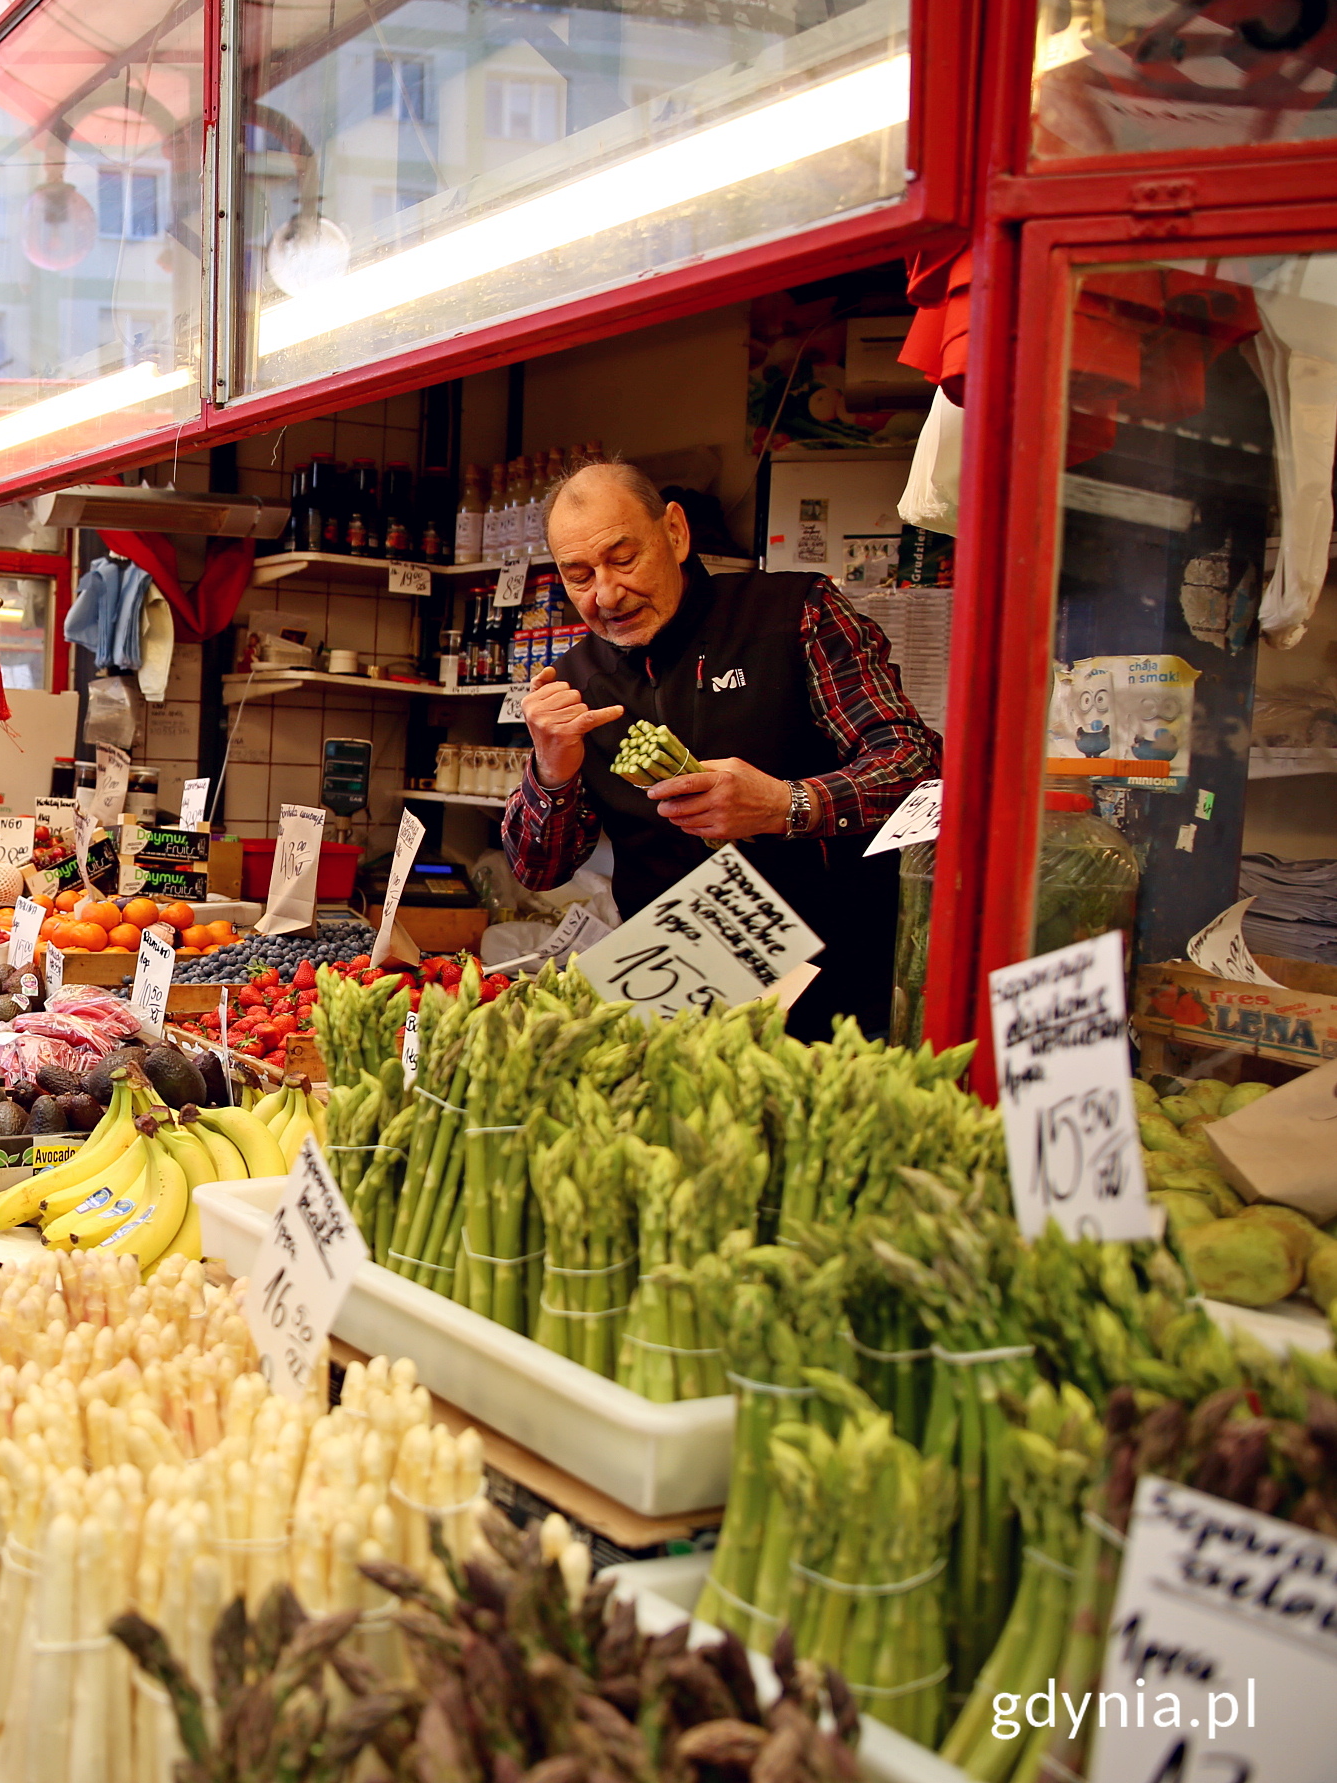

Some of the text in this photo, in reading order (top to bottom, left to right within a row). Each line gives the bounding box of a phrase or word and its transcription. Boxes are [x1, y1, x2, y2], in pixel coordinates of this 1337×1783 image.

[1139, 674, 1180, 684] smak!
[16, 899, 38, 915] MALINA
[541, 908, 585, 956] RATUSZ
[1209, 991, 1270, 1005] Fres
[1214, 1005, 1319, 1050] LENA
